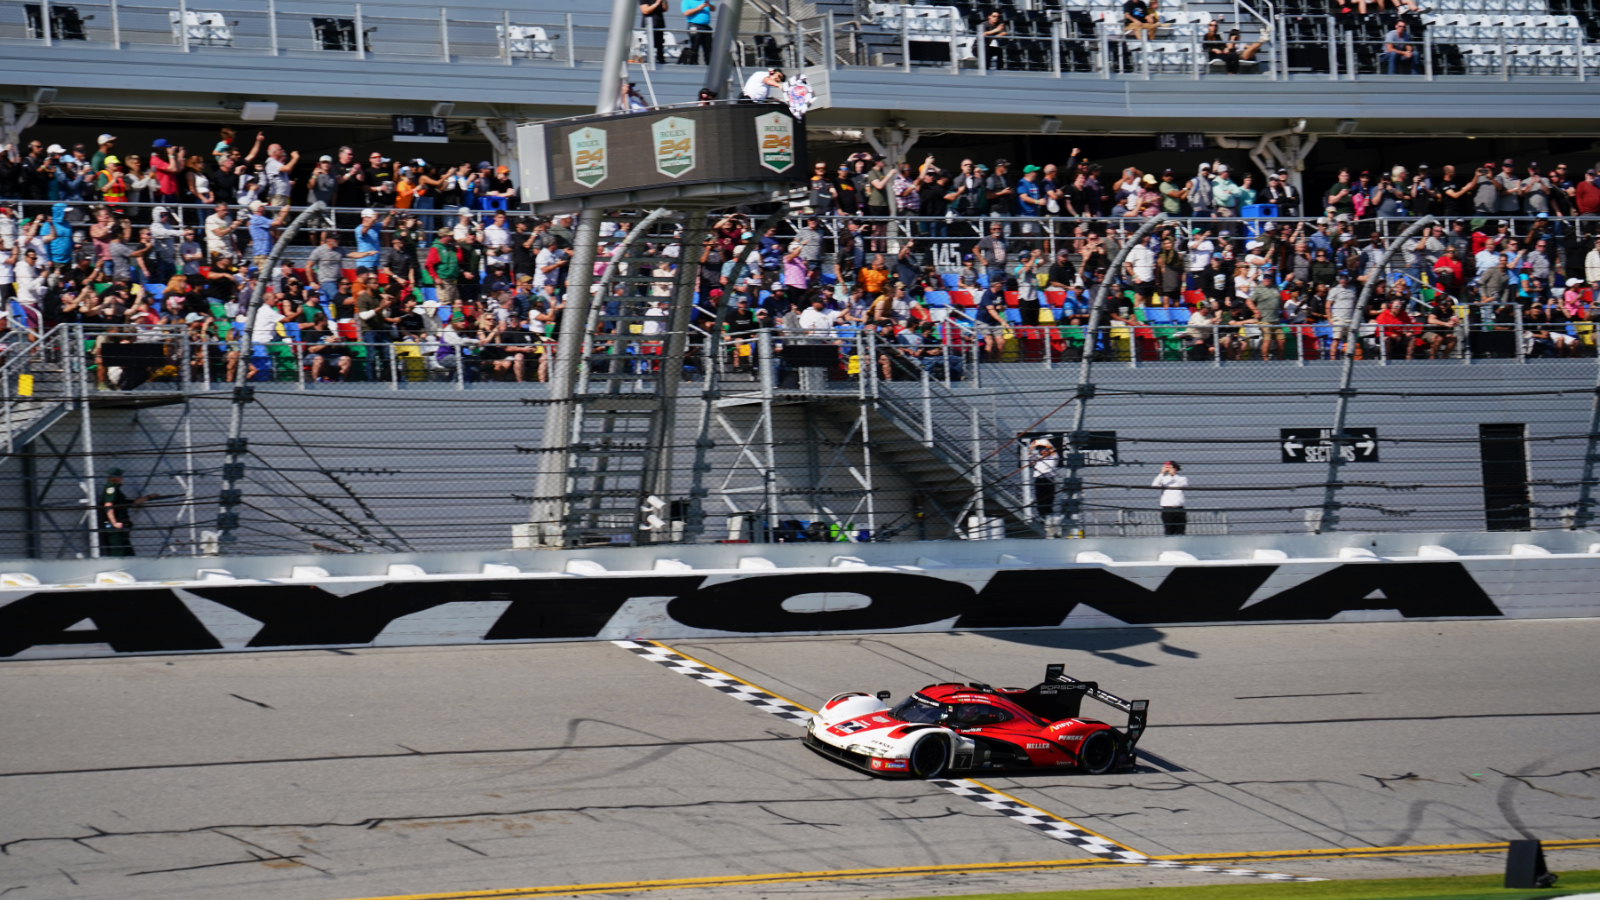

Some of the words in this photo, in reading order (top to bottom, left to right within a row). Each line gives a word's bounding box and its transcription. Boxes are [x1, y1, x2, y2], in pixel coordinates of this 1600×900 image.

[397, 117, 415, 132] 146
[427, 118, 445, 133] 145
[658, 137, 691, 155] 24
[762, 134, 791, 149] 24
[1160, 134, 1177, 148] 145
[1187, 134, 1204, 148] 144
[575, 147, 604, 165] 24
[930, 242, 962, 271] 145
[960, 755, 967, 767] 7
